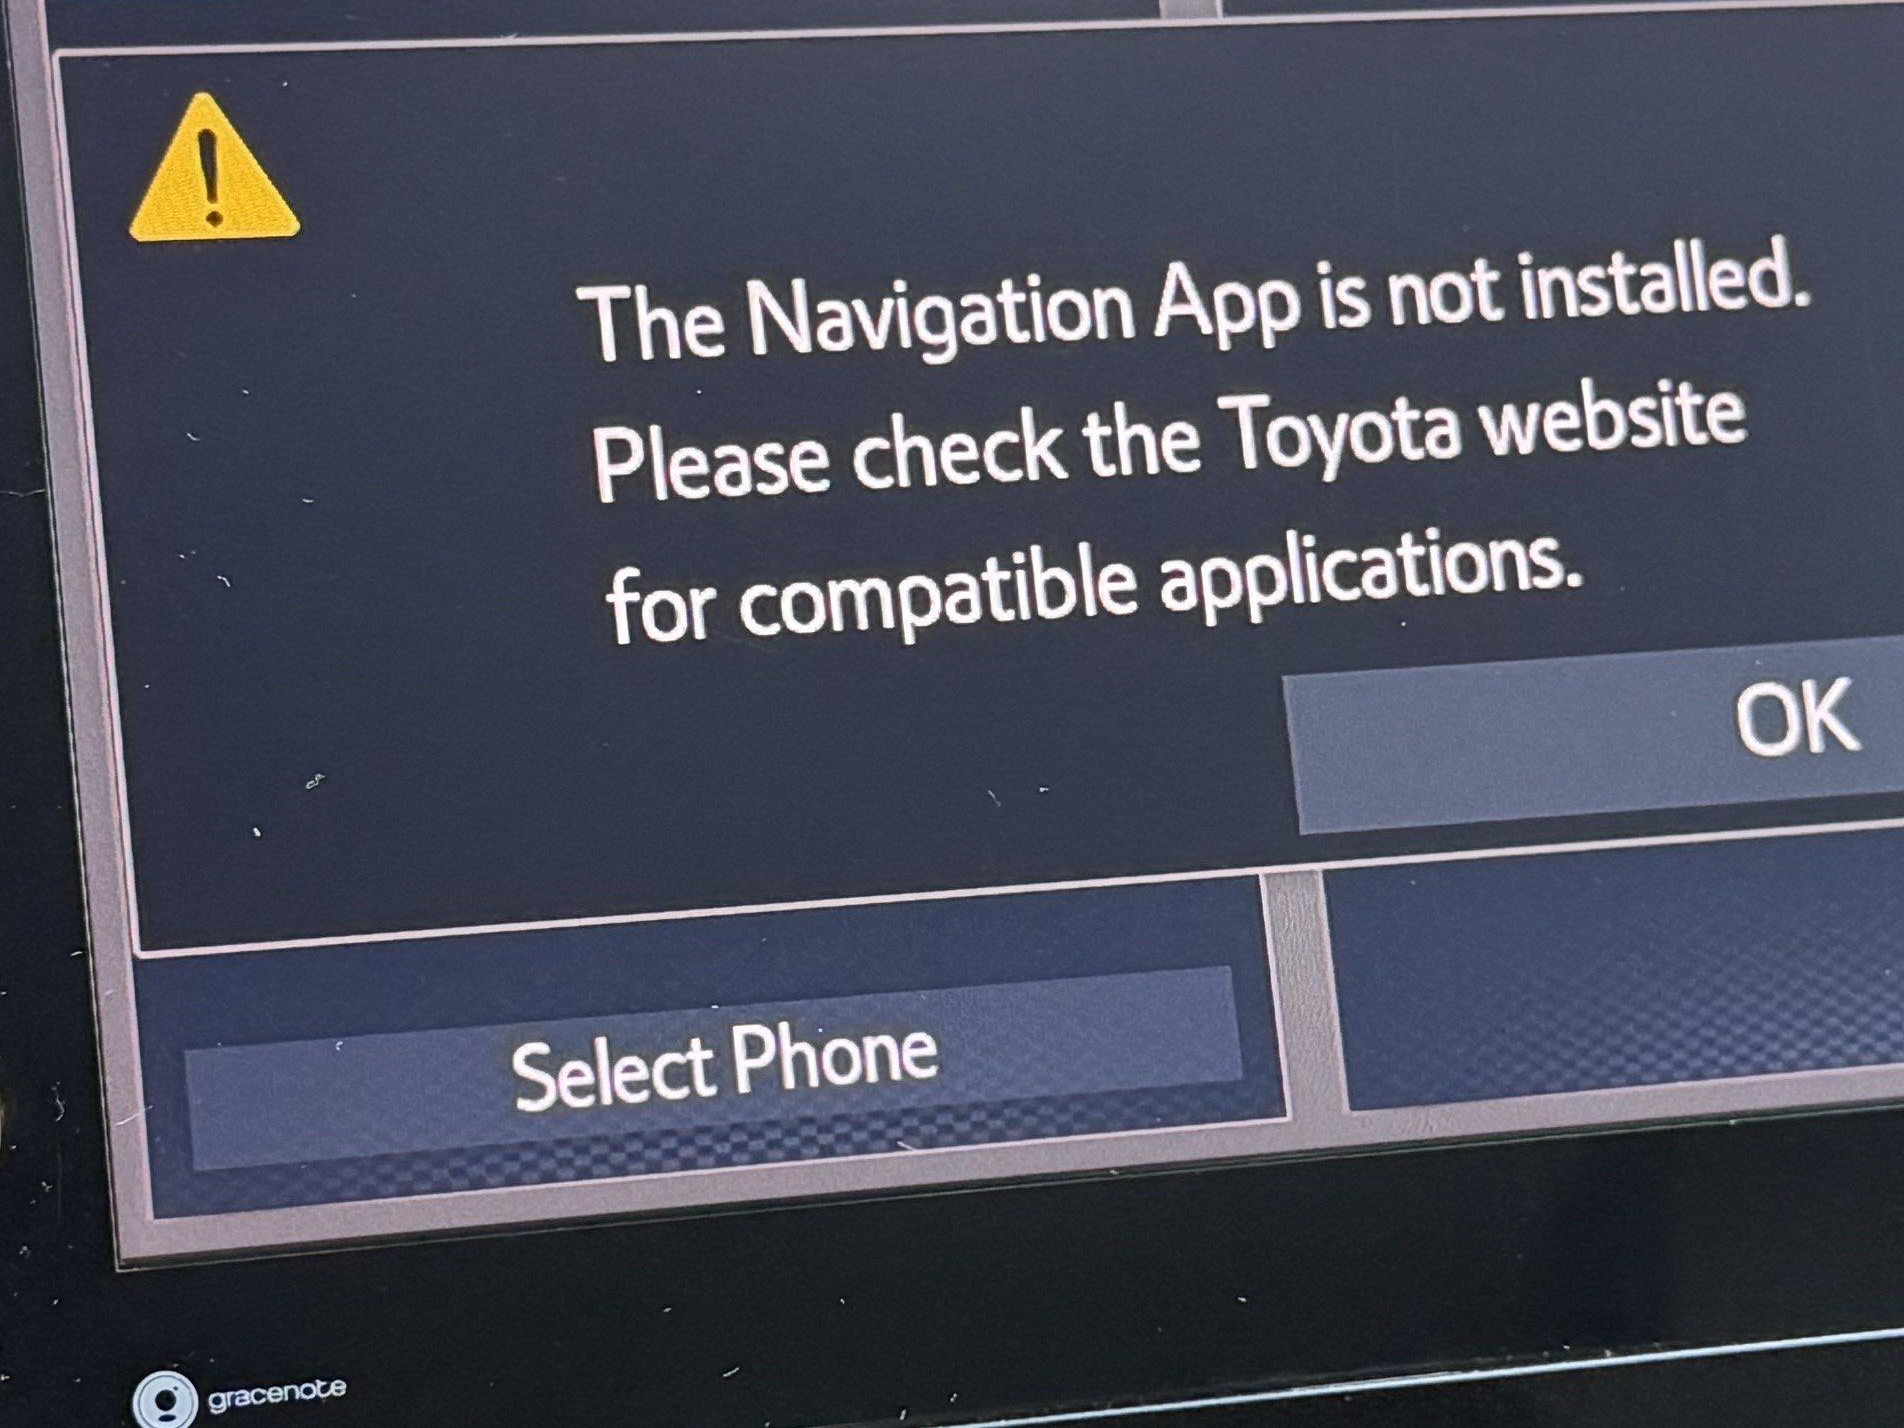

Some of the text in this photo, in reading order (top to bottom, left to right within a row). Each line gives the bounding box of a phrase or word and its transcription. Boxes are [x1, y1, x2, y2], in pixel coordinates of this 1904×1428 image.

[575, 234, 1811, 365] The Navigation App is not installed.
[593, 376, 1747, 504] Please check the Toyota website
[605, 526, 1583, 646] for compatible applications.
[1737, 676, 1861, 757] OK
[512, 1021, 939, 1112] Select Phone
[207, 1379, 347, 1415] gracenote
